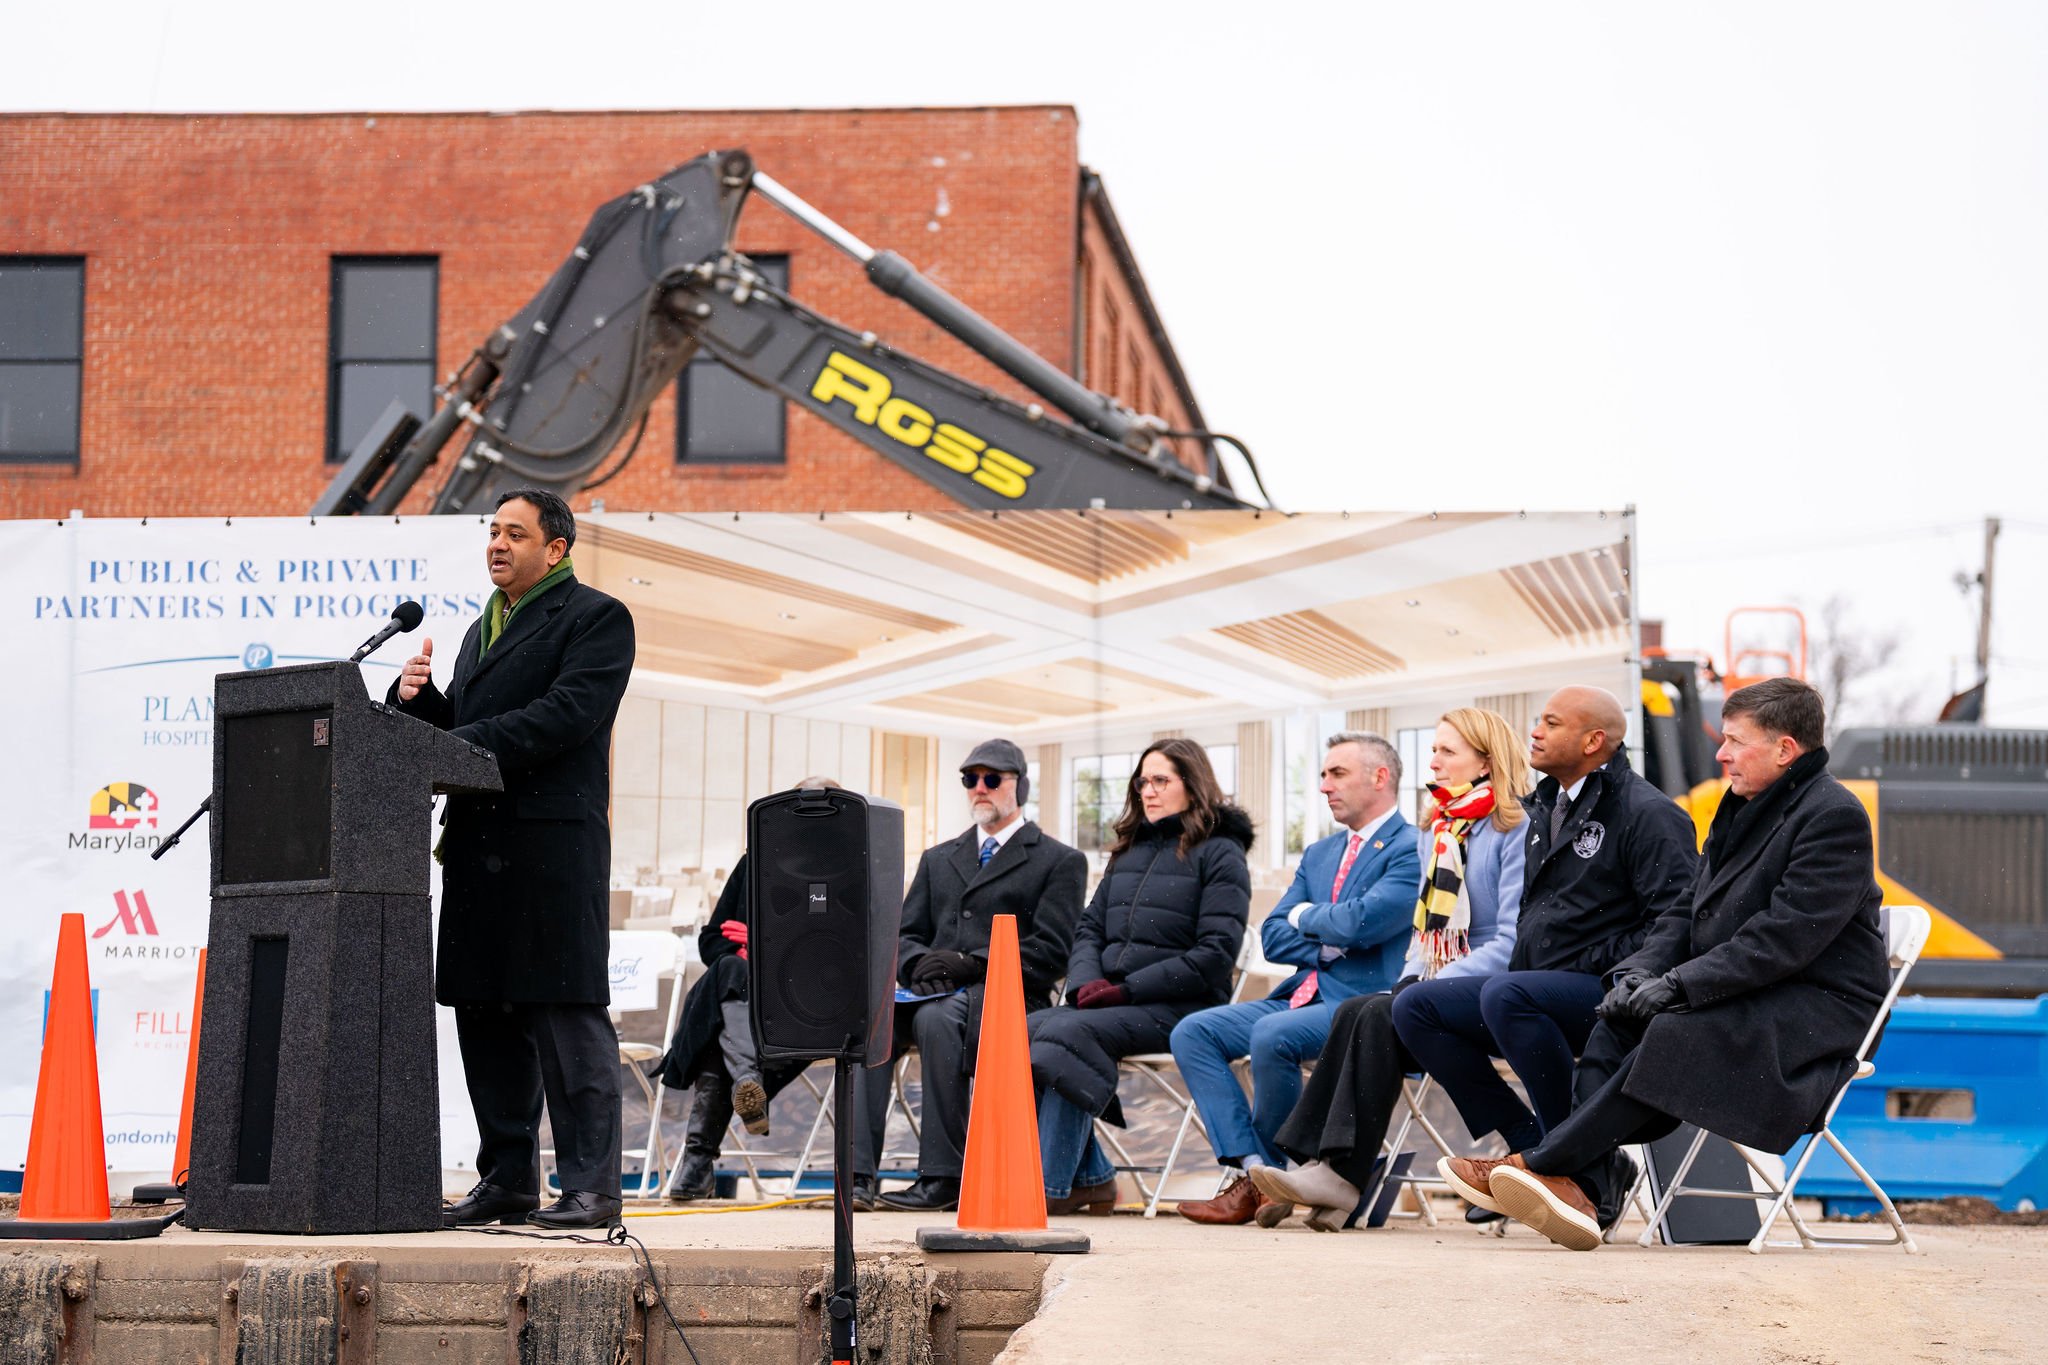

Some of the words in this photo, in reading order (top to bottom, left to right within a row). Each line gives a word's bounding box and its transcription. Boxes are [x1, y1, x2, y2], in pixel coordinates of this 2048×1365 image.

[88, 559, 221, 584] PUBLIC
[235, 559, 261, 584] &
[277, 557, 428, 583] PRIVATE
[34, 594, 224, 619] PARTNERS
[240, 595, 276, 618] IN
[68, 832, 176, 854] Marylan
[135, 1011, 188, 1035] FILL
